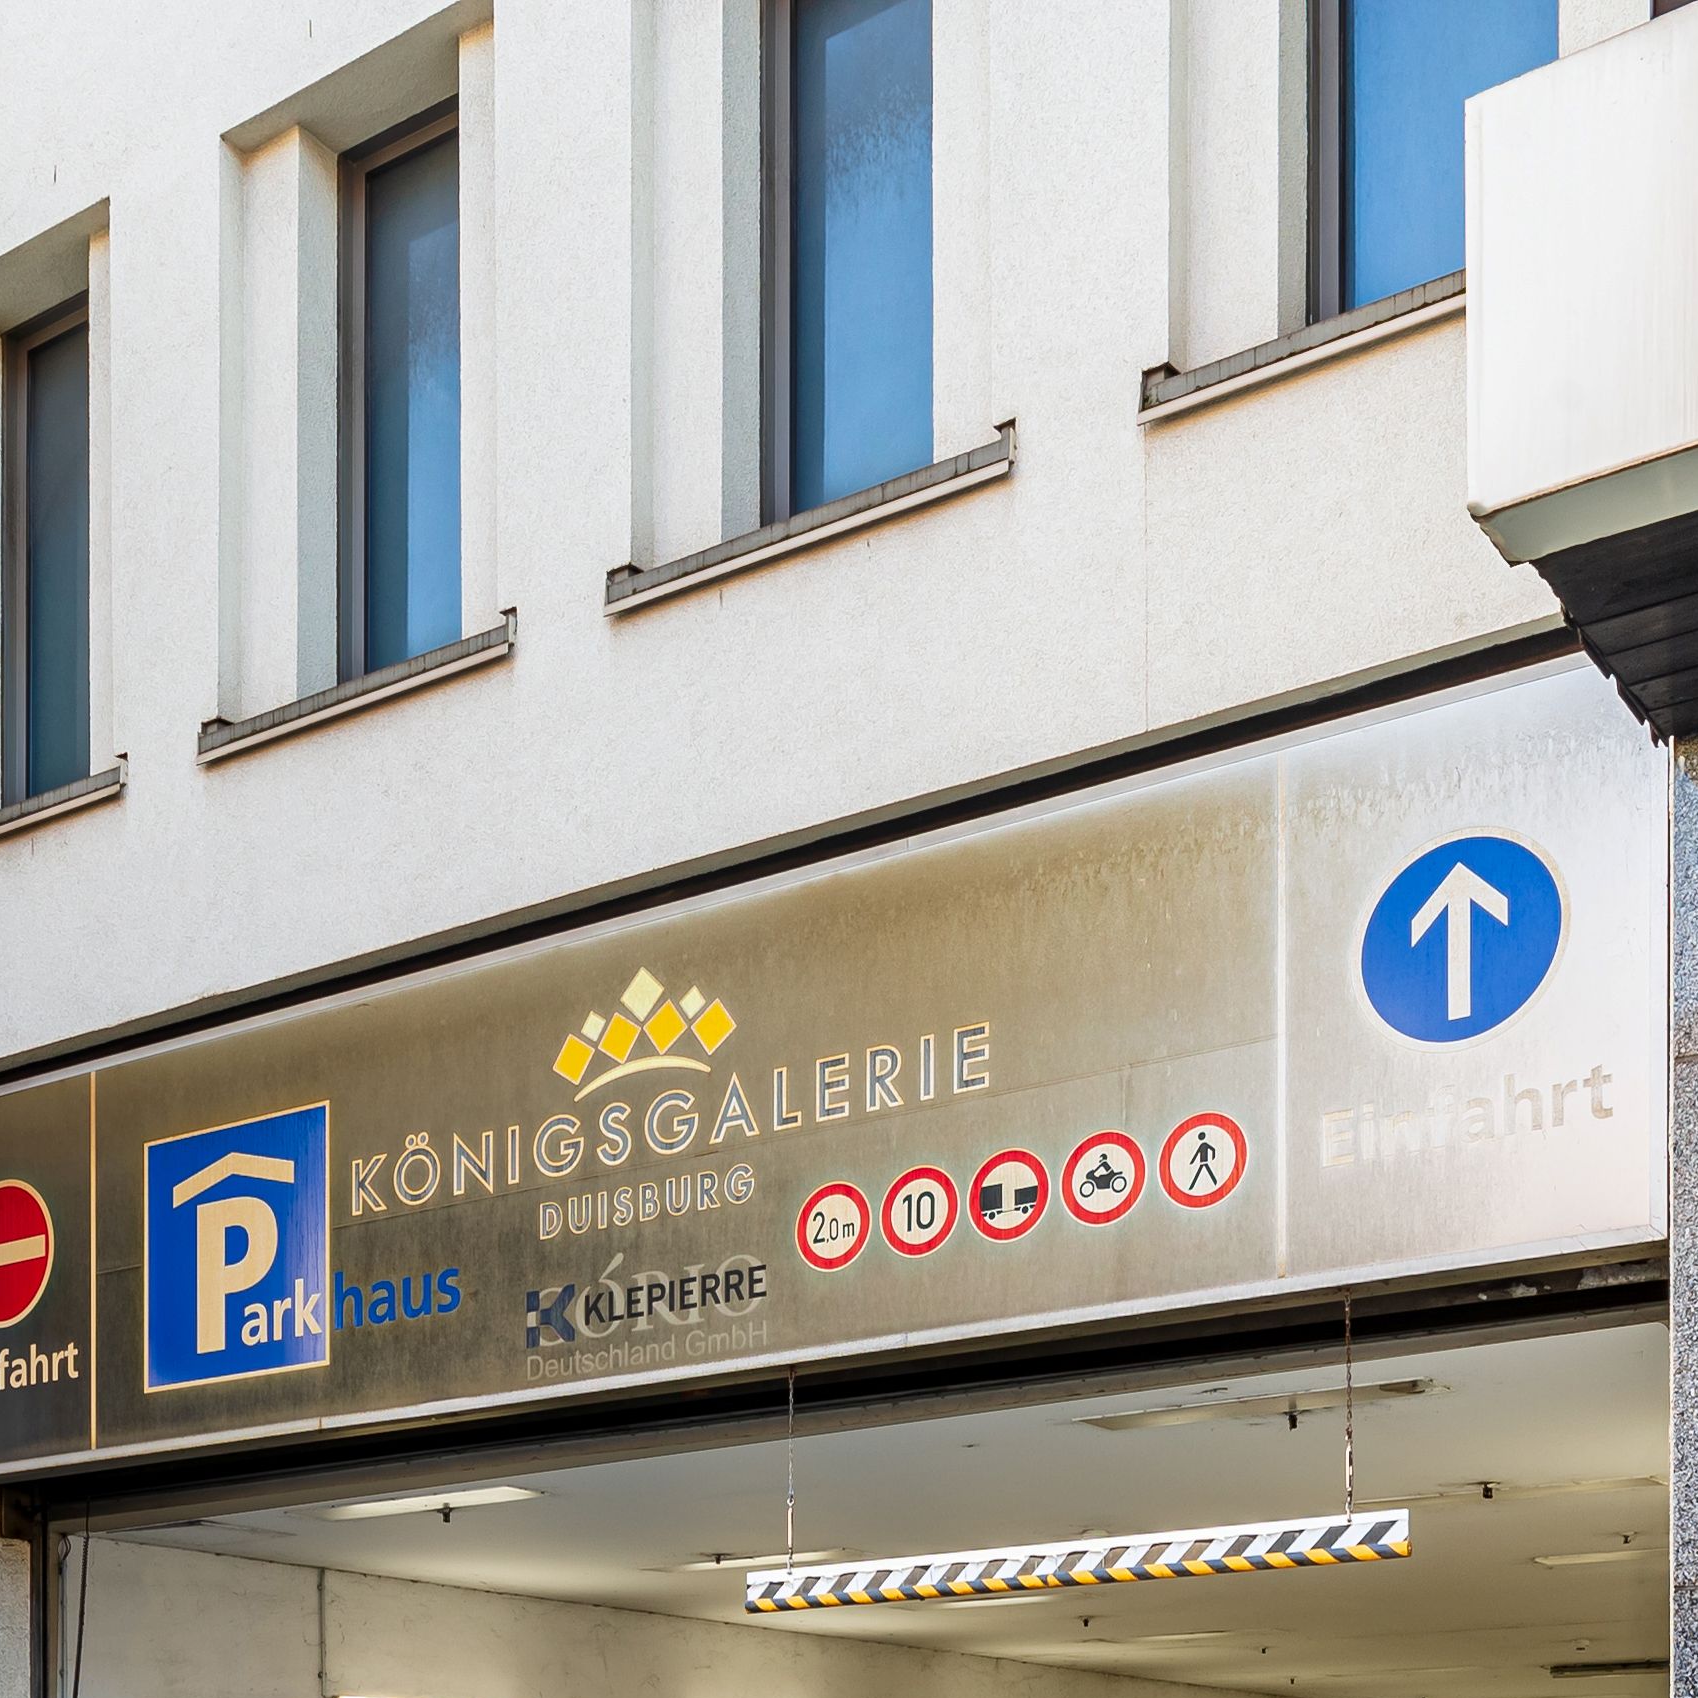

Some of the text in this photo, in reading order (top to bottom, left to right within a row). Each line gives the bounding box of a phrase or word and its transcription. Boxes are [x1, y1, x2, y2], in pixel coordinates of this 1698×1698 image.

[350, 1020, 991, 1217] KÖNIGSGALERIE
[1321, 1063, 1614, 1168] Einfahrt
[538, 1162, 755, 1241] DUISBURG
[902, 1190, 936, 1232] 10
[584, 1264, 768, 1326] KLEPIERRE
[526, 1319, 768, 1382] Deutschland GmbH
